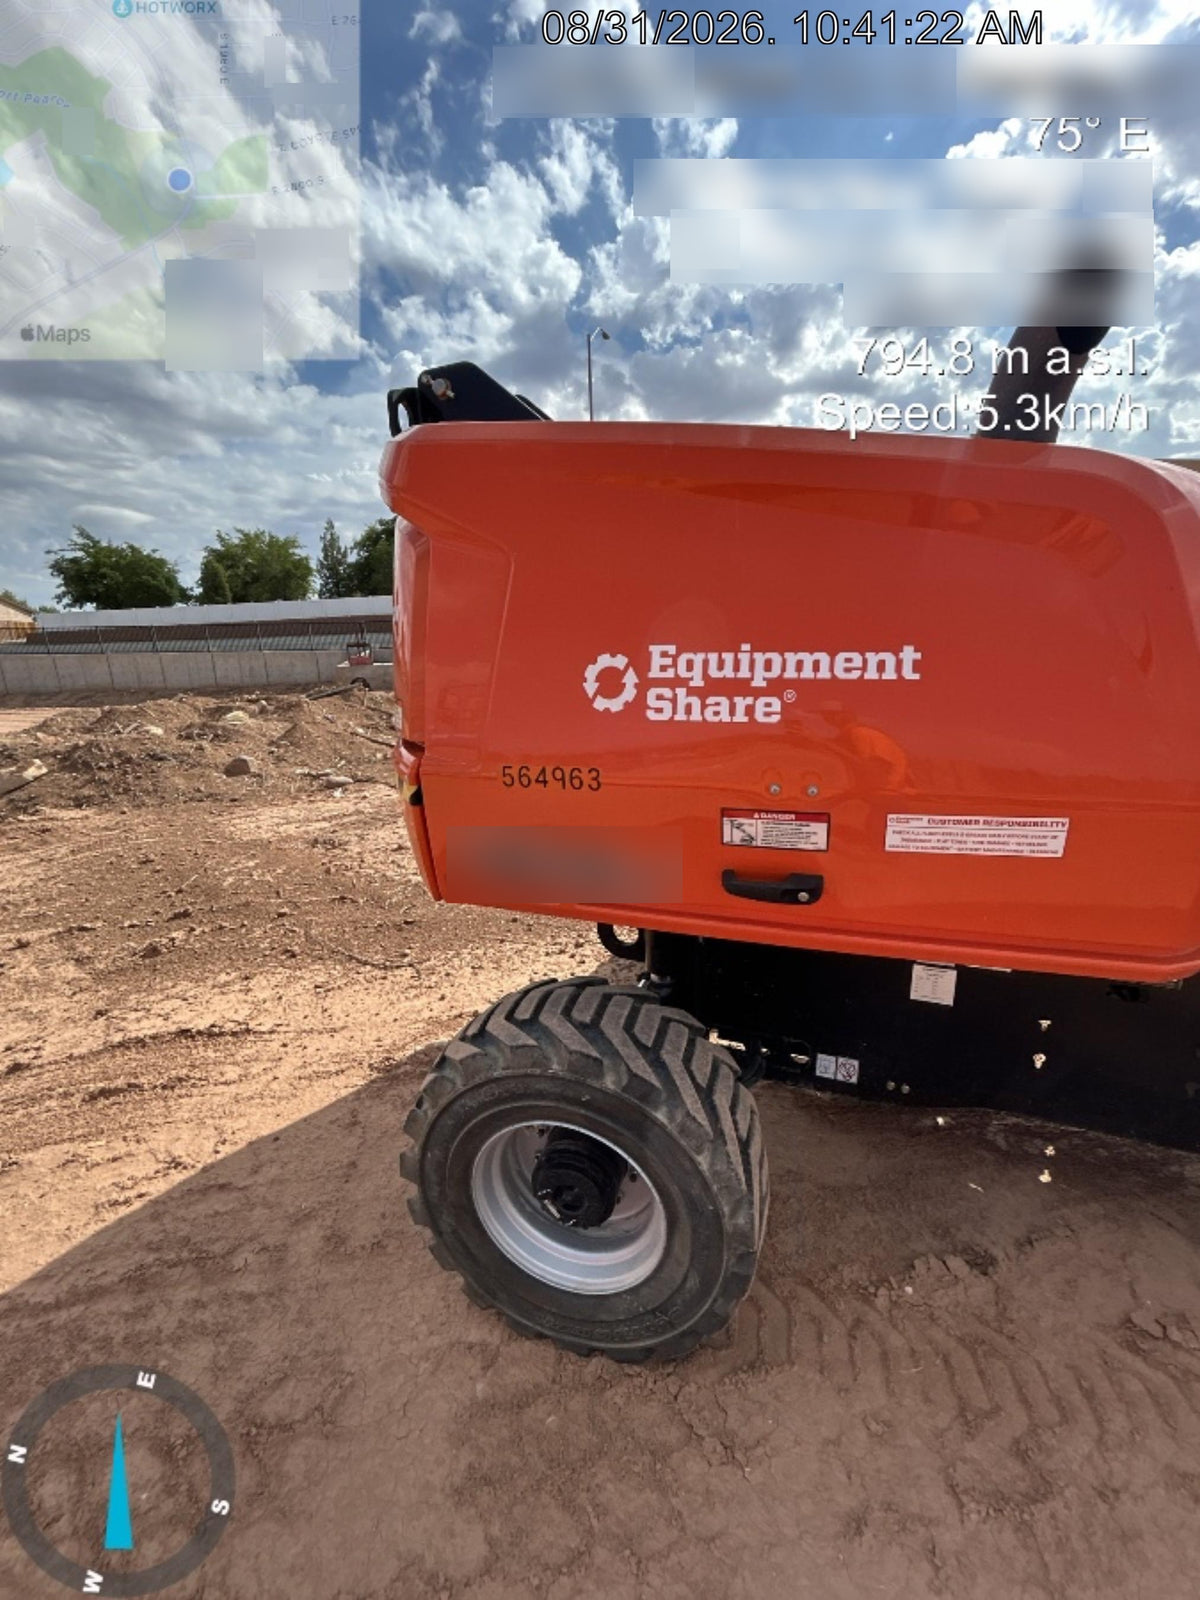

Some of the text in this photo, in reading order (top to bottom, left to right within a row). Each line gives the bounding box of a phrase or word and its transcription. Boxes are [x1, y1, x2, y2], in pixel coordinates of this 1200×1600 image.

[647, 643, 922, 687] Equipment
[502, 765, 602, 792] 564963
[926, 817, 980, 827] CUSTOMER
[982, 819, 1068, 829] RESPONSIBILITY
